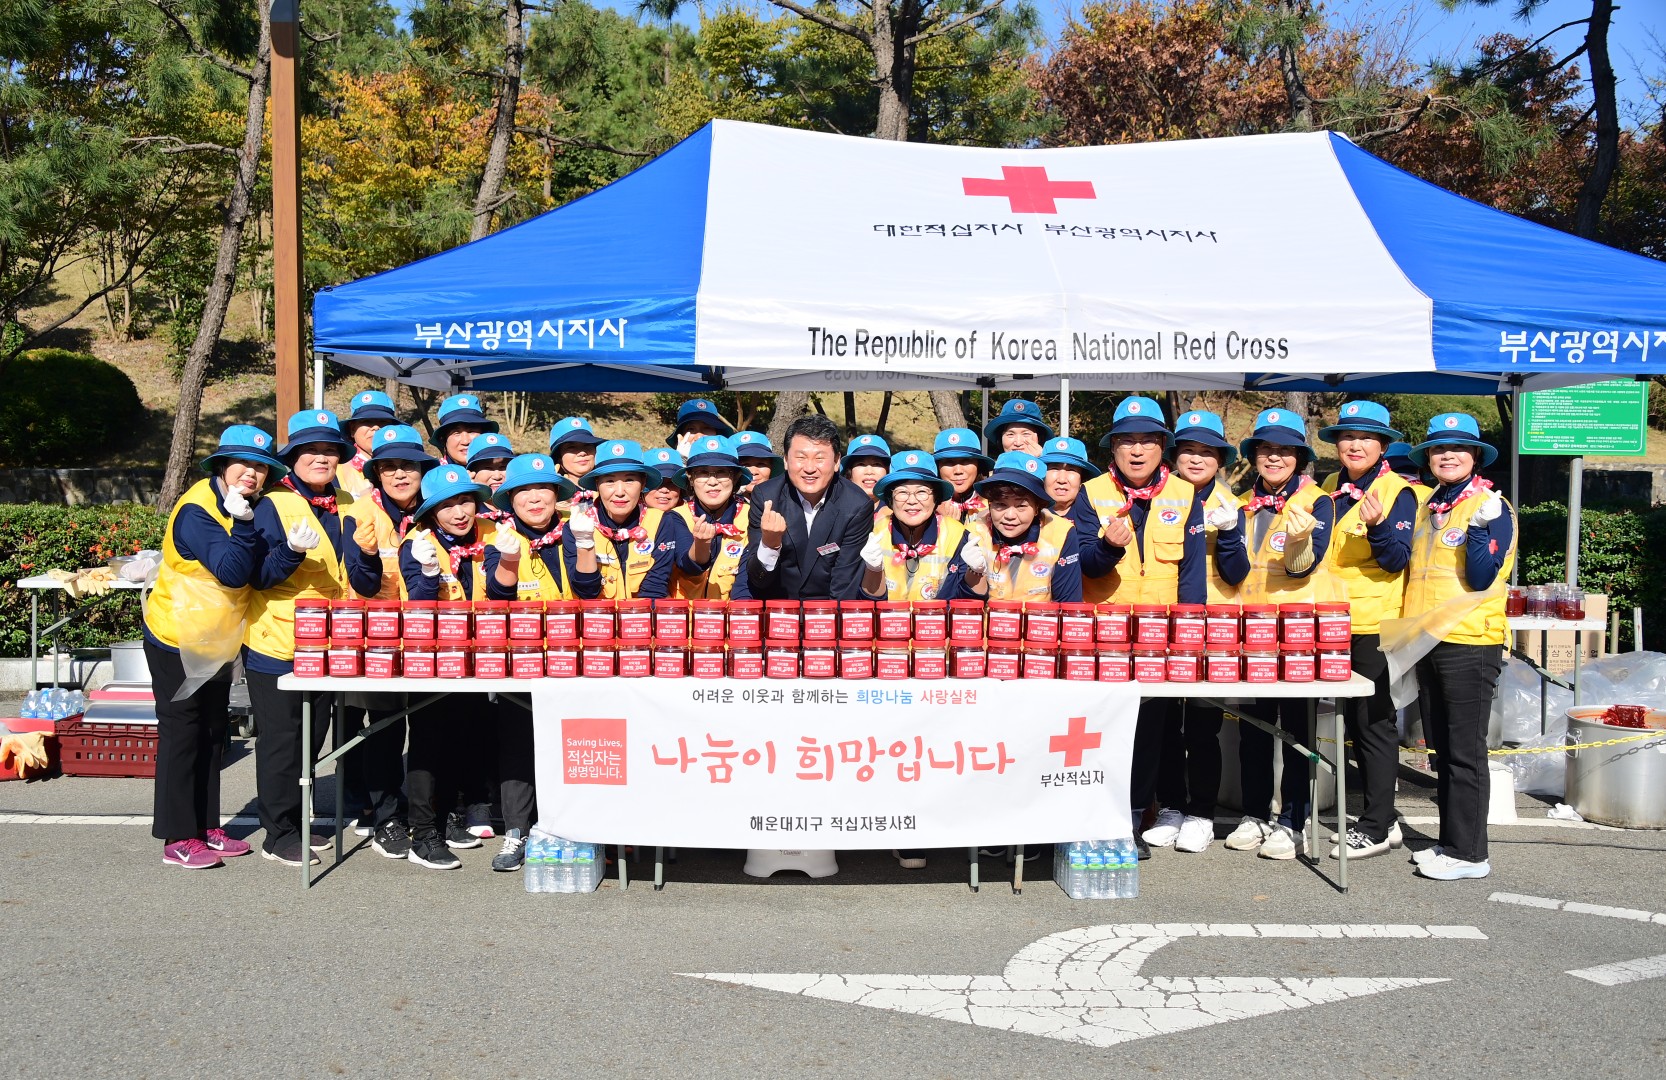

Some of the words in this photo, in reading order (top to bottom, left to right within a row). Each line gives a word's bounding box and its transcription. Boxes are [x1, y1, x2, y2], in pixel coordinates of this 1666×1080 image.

[873, 223, 1023, 238] 대한적십자사
[1044, 223, 1218, 244] 부산광역시지사
[414, 317, 628, 351] 부산광역시지사
[807, 326, 848, 357] The
[854, 328, 947, 364] Republic
[954, 329, 977, 359] of
[991, 331, 1057, 361] Korea
[1072, 331, 1162, 361] National
[1173, 331, 1216, 361] Red
[1225, 330, 1289, 360] Cross
[692, 688, 735, 704] 어려운
[742, 688, 785, 704] 이웃과
[791, 688, 849, 705] 함께하는
[856, 689, 913, 705] 희망나눔
[920, 689, 977, 705] 사랑실천
[566, 737, 597, 749] Saving
[598, 738, 623, 749] Lives,
[567, 749, 622, 766] 적십자는
[651, 732, 777, 784] 나눔이
[795, 735, 1016, 783] 희망입니다
[567, 765, 623, 779] 생명입니다.
[1040, 770, 1105, 788] 부산적십자
[750, 815, 823, 832] 해운대지구
[830, 815, 916, 832] 적십자봉사회
